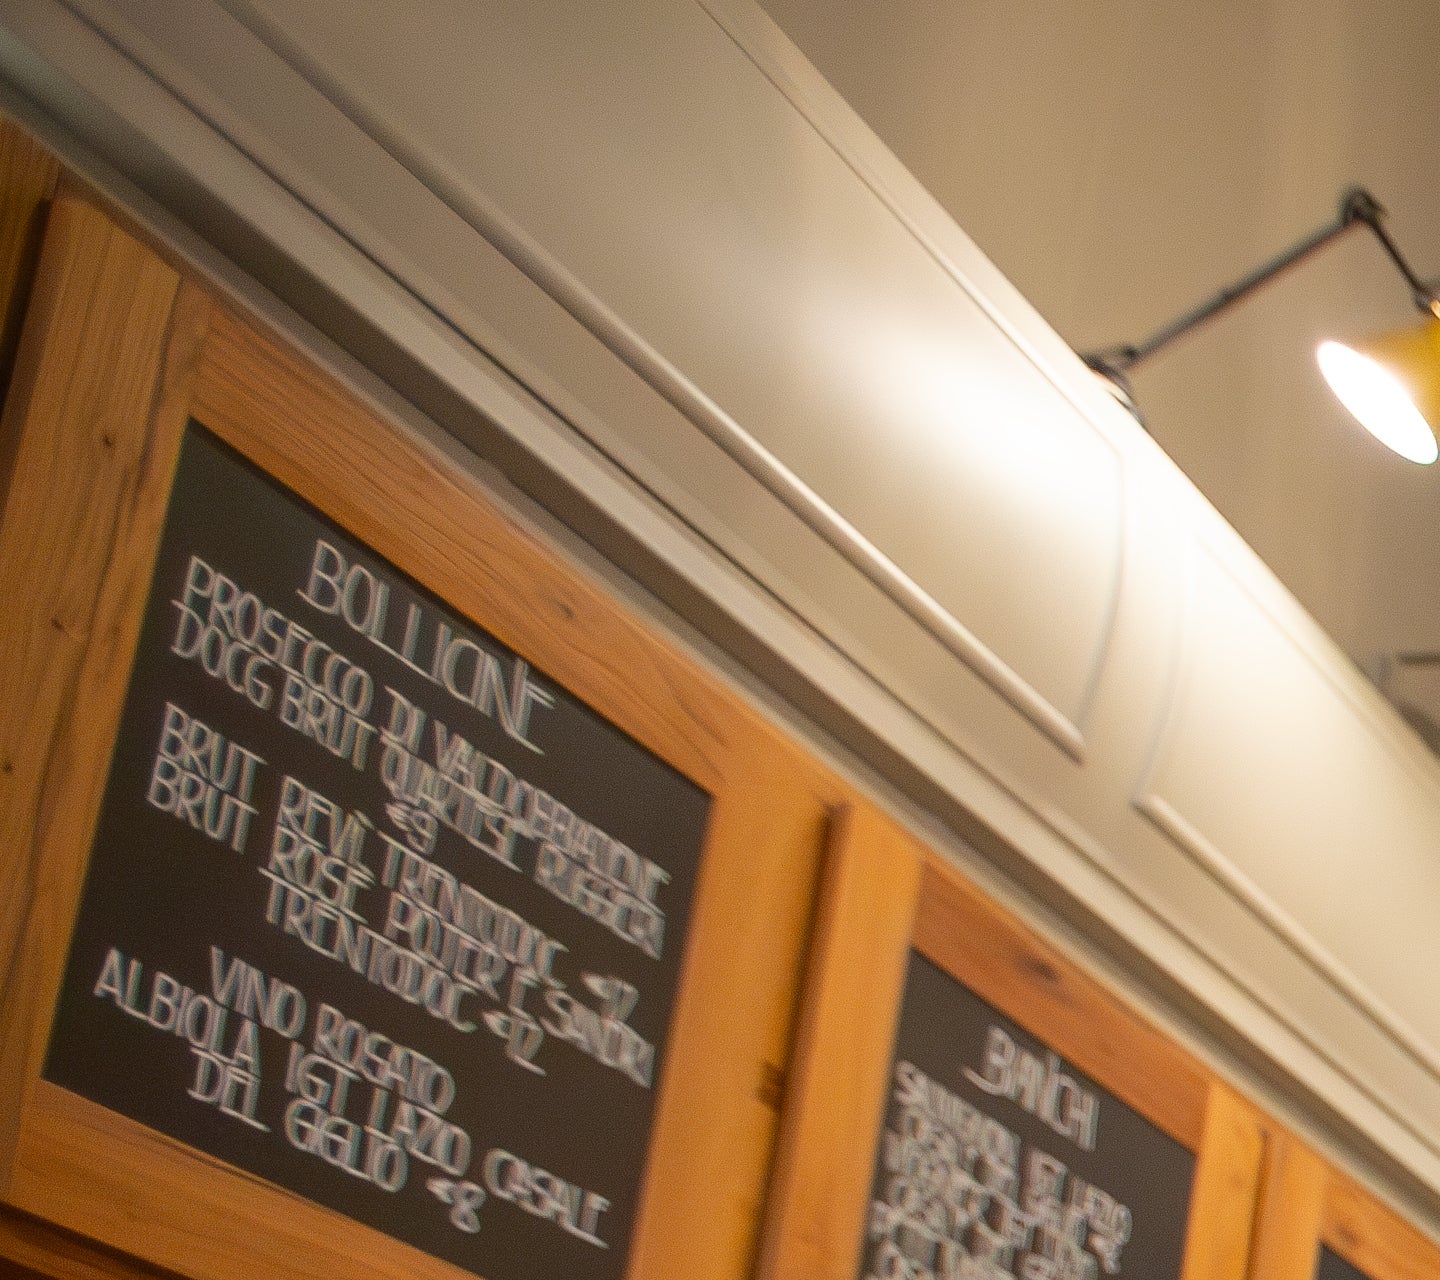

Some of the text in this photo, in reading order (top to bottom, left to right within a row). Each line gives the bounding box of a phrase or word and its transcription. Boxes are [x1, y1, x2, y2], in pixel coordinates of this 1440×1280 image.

[171, 599, 272, 709] DOCG
[279, 674, 381, 770] BRUT
[181, 555, 374, 719] PROSECCO
[297, 539, 557, 755] BOLLICINE
[147, 753, 260, 855] BRUT
[156, 701, 268, 803] BRUT
[93, 947, 261, 1079] ALBIOLA
[210, 944, 455, 1116] VINO ROSATO
